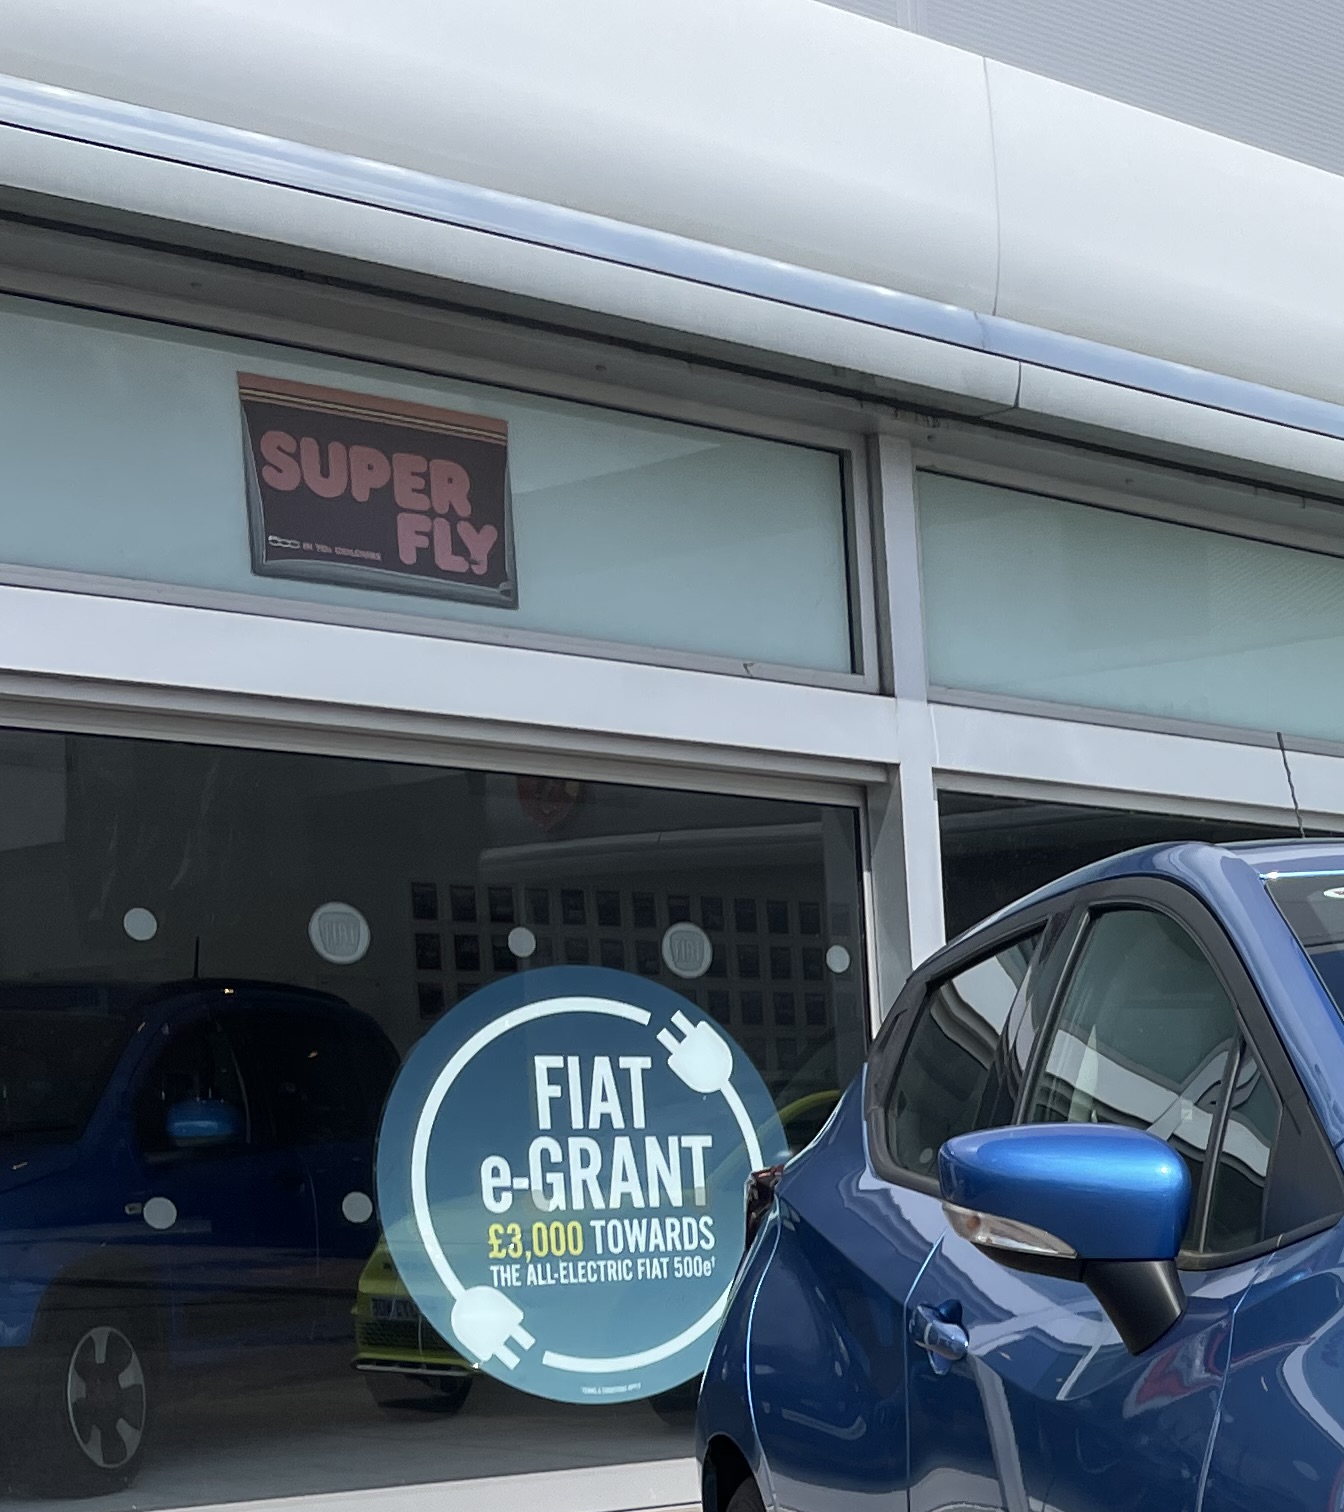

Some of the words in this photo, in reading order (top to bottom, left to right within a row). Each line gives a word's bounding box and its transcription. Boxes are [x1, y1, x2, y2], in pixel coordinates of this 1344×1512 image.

[260, 430, 472, 518] SUPER
[396, 511, 498, 576] FLY
[533, 1054, 652, 1130] FIAT
[480, 1134, 713, 1214] e-GRANT
[487, 1220, 584, 1263] £3,000
[589, 1215, 716, 1255] TOWARDS
[489, 1263, 522, 1288] THE
[526, 1258, 634, 1286] ALL-ELECTRIC
[637, 1256, 670, 1282] FIAT
